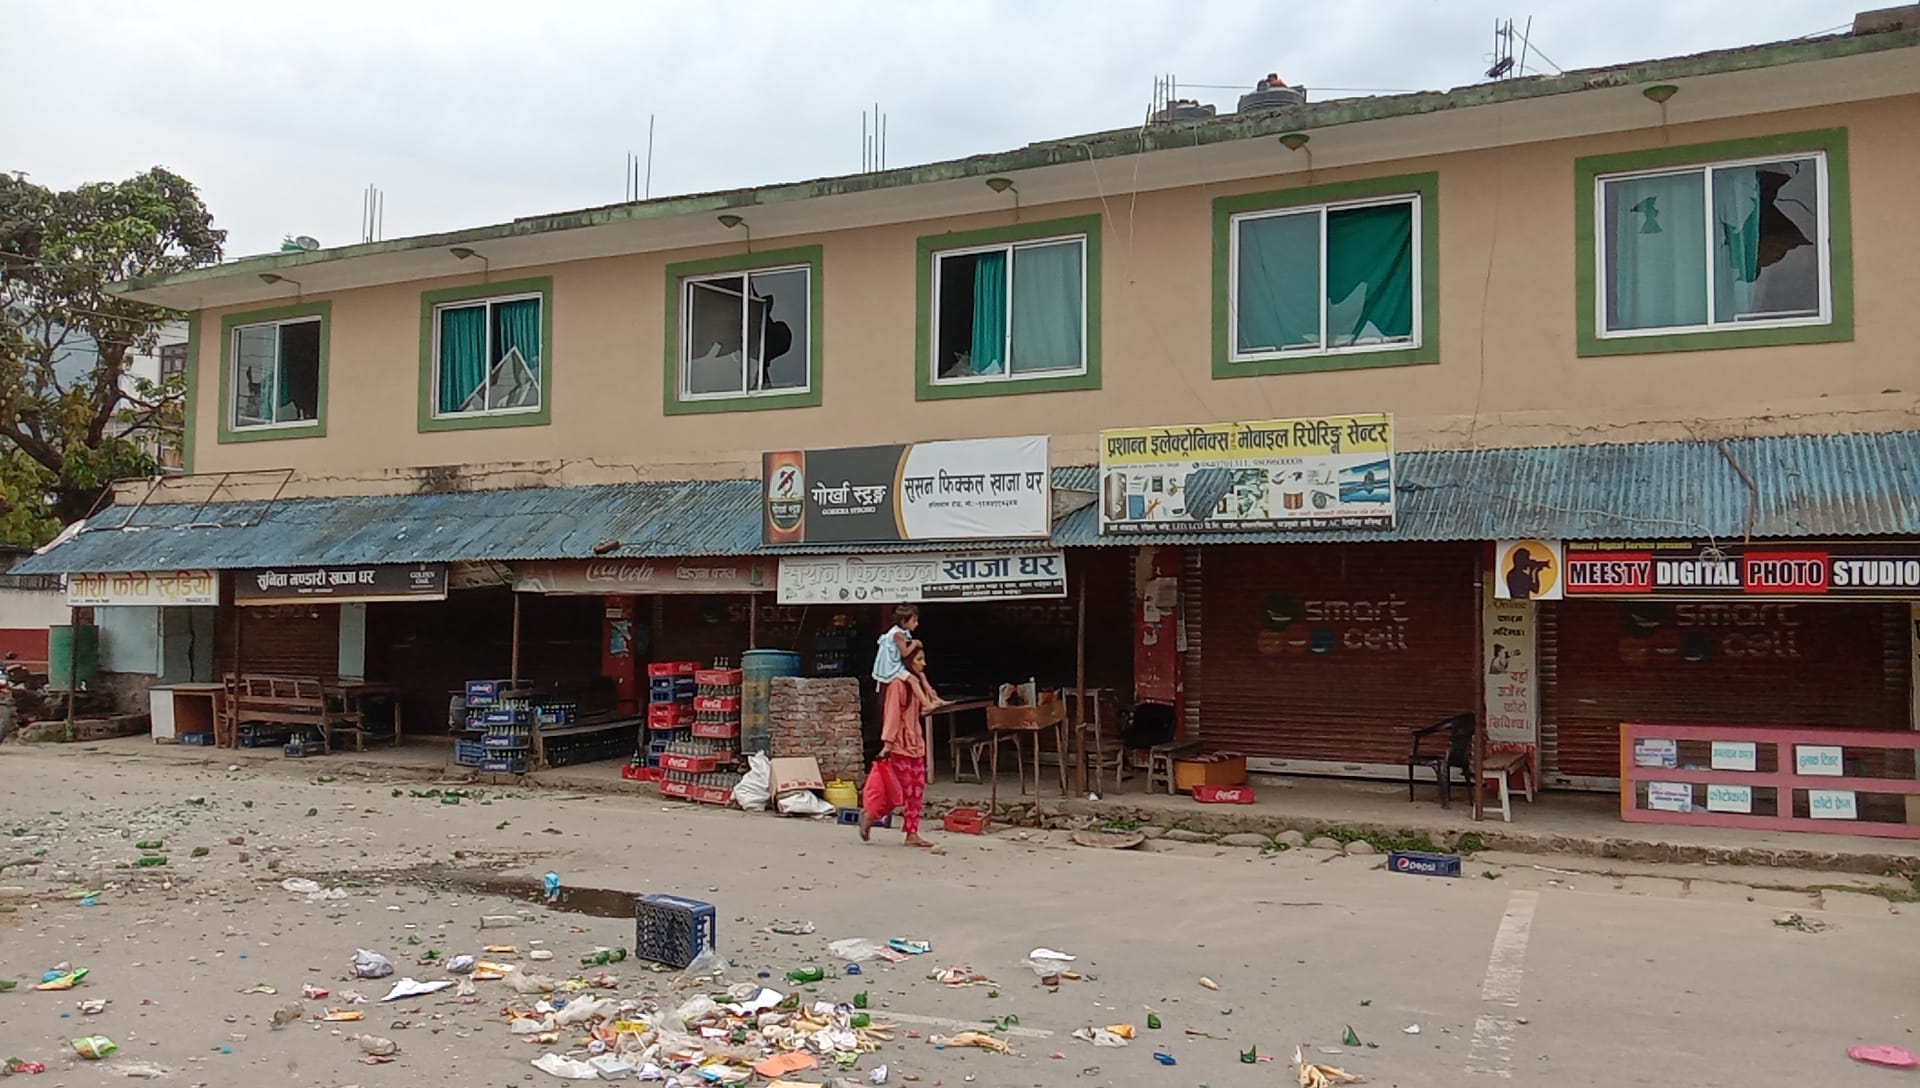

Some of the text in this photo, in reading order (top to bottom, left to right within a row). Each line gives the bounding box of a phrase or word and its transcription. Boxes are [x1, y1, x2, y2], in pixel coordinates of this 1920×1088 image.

[1107, 436, 1147, 457] प्रशान्त
[1347, 418, 1389, 445] सेन्टर
[810, 481, 850, 506] गोर्खा
[904, 476, 935, 503] सुसन
[989, 473, 1021, 496] खाजा
[1025, 471, 1045, 494] घर
[358, 569, 376, 585] घर
[942, 557, 1011, 580] खाजा
[1018, 555, 1059, 576] घर
[1568, 559, 1920, 586] MEESTY DIGITAL PHOTO STUDIO
[70, 572, 107, 598] जोशी
[112, 571, 152, 598] फोटो
